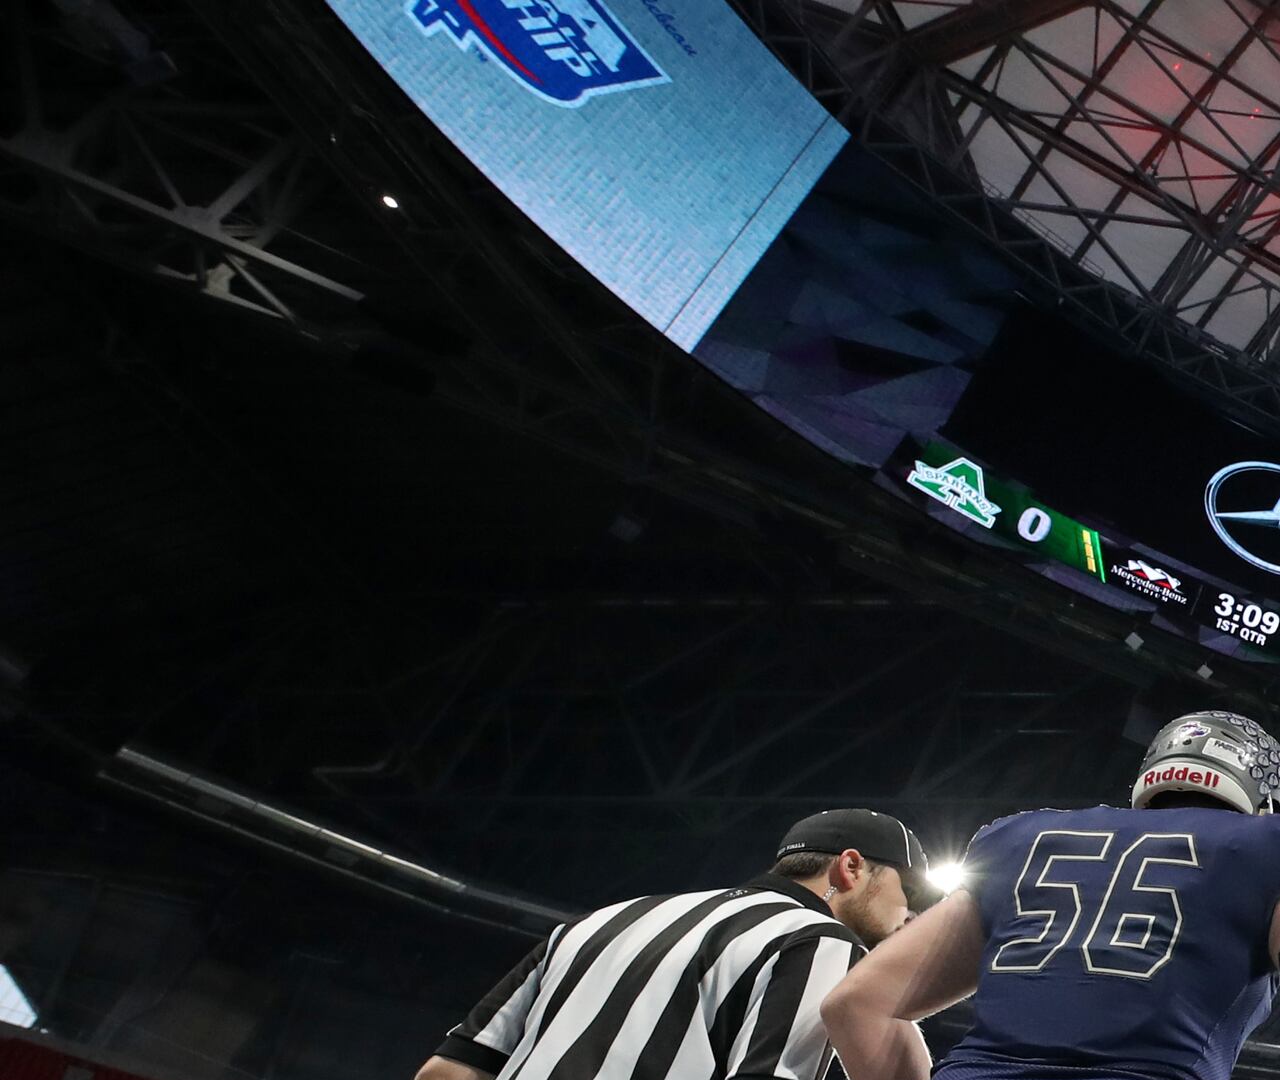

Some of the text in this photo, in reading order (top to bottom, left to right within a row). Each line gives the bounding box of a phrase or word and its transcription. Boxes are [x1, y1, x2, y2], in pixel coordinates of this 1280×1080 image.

[924, 470, 995, 515] SPARTANS
[1017, 507, 1051, 542] 0
[1111, 564, 1187, 605] Mercedes-Benz
[1125, 580, 1169, 602] STADIUM
[1213, 592, 1280, 635] 3:09
[1215, 617, 1267, 647] 1ST QTR
[1144, 767, 1220, 788] Riddell
[990, 830, 1200, 980] 56
